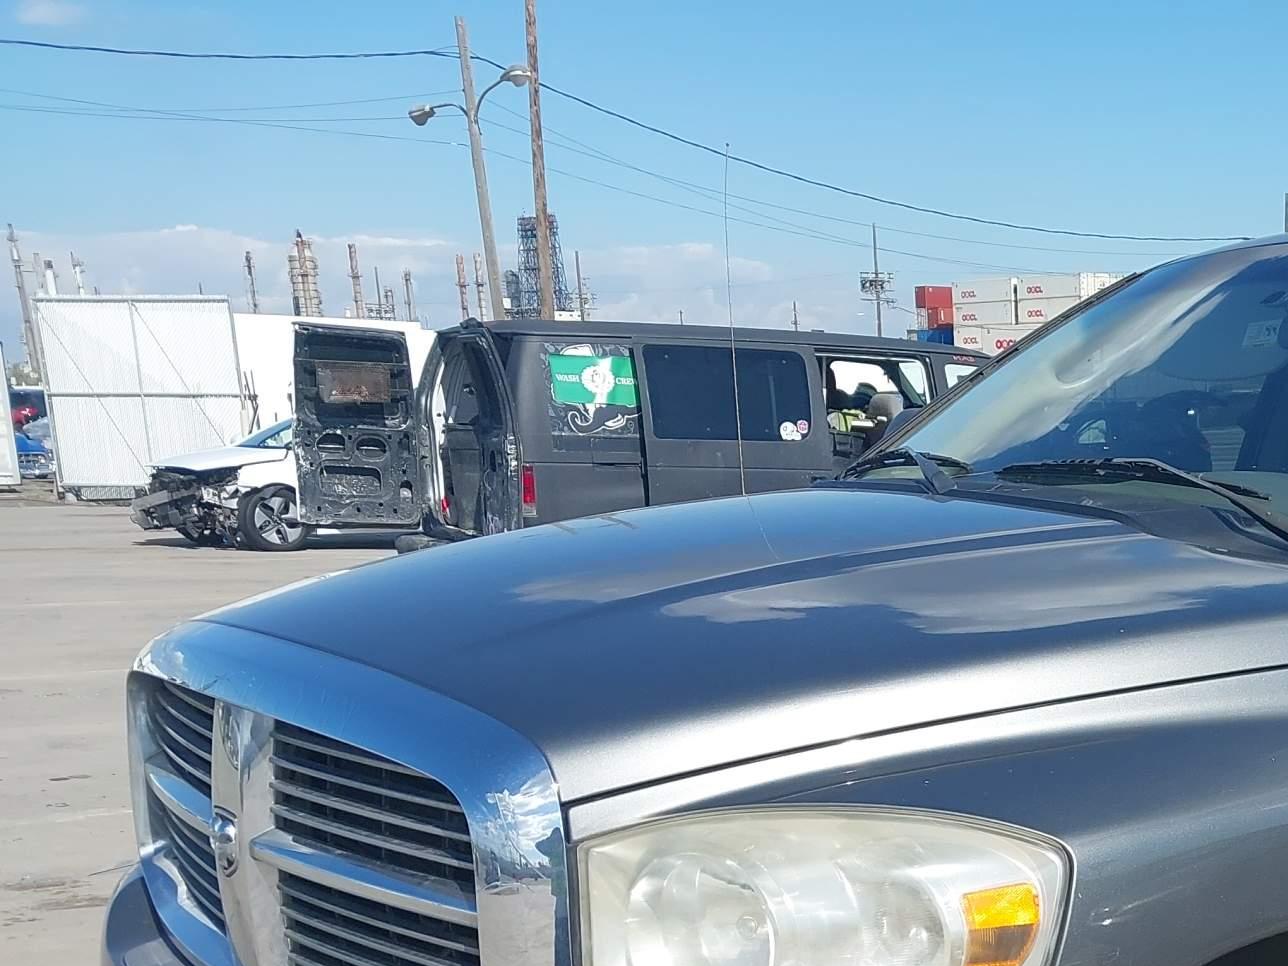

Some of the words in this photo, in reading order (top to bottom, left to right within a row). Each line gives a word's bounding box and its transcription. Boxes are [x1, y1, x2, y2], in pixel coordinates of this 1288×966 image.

[1026, 285, 1044, 295] OOCL
[1027, 309, 1045, 318] OOCL
[995, 339, 1017, 350] OOC
[555, 373, 580, 383] WASH
